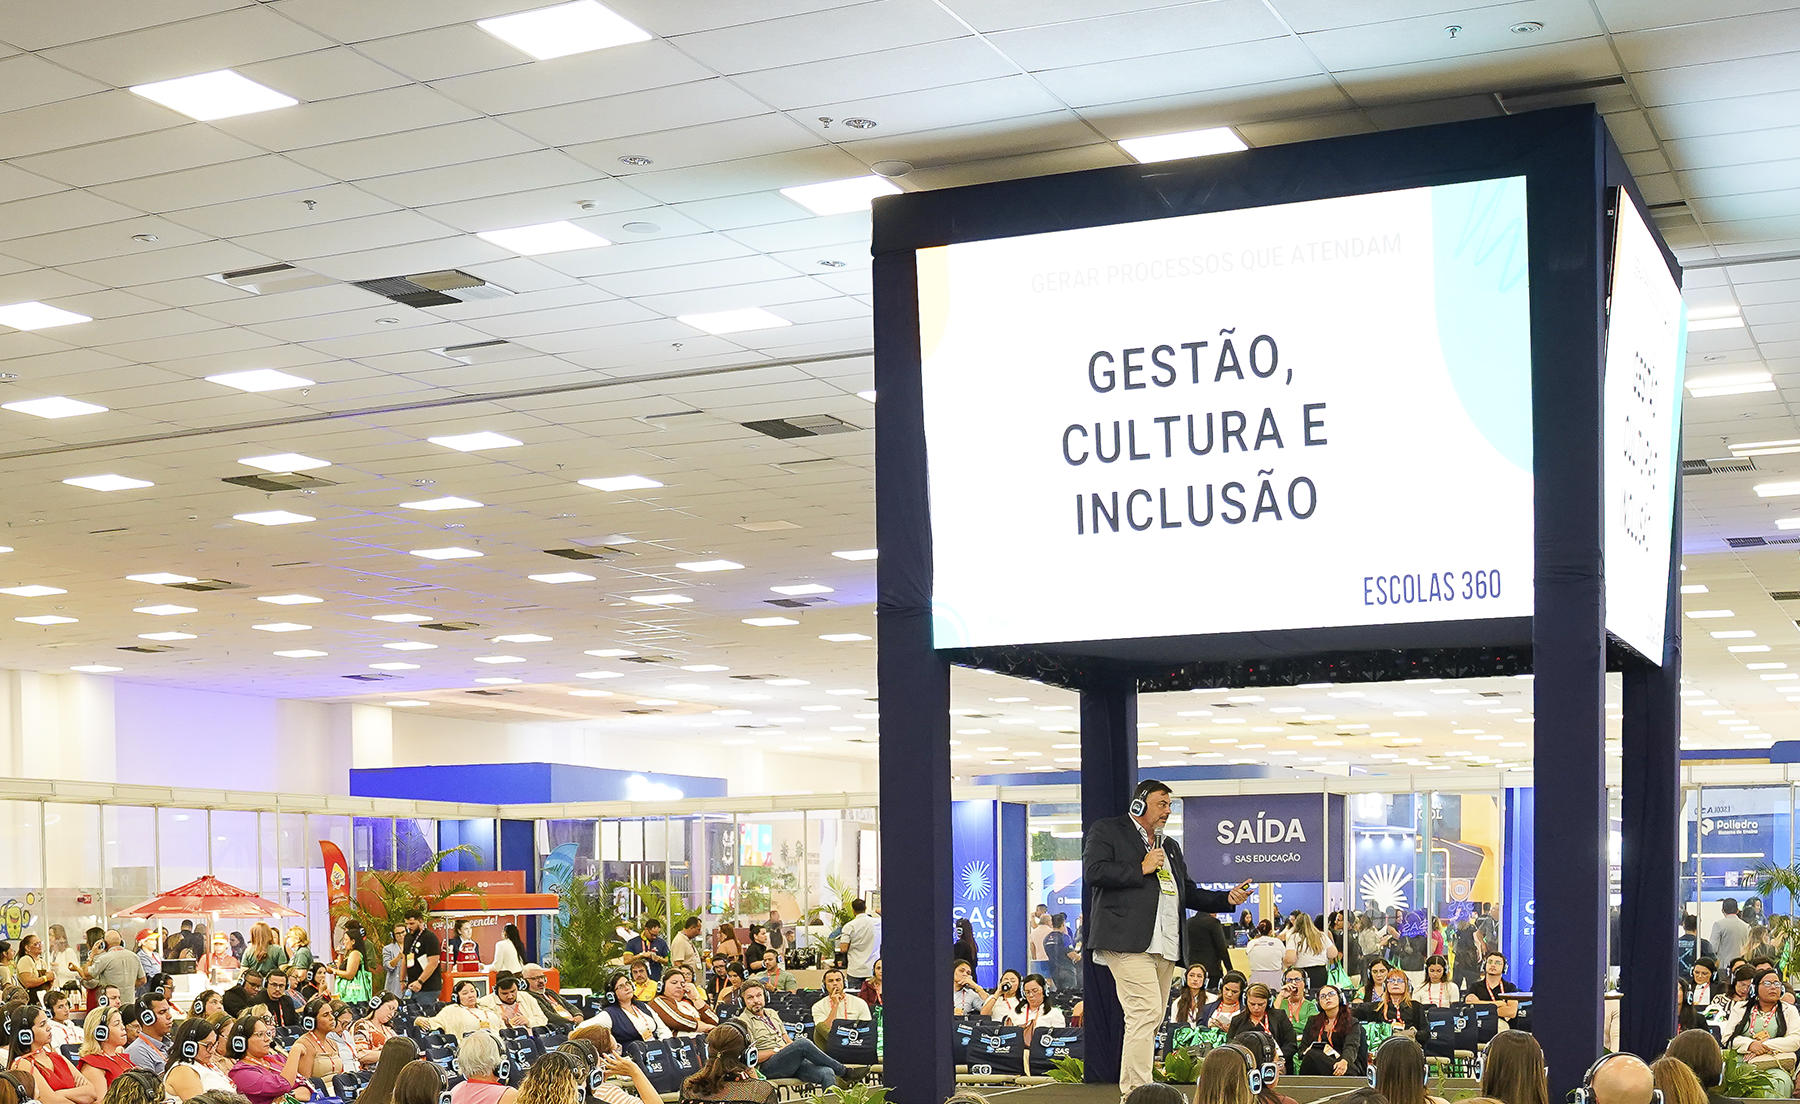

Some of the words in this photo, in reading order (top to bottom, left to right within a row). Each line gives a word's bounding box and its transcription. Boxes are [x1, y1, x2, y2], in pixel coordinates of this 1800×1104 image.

[1031, 267, 1100, 294] GERAR
[1106, 252, 1235, 286] PROCESSOS
[1240, 246, 1285, 272] QUE
[1291, 232, 1402, 265] ATENDAM
[1087, 326, 1295, 394] GESTÃO,
[1062, 407, 1285, 466] CULTURA
[1303, 402, 1329, 447] E
[1075, 467, 1318, 536] INCLUSÃO
[1364, 572, 1455, 606] ESCOLAS
[1462, 569, 1501, 599] 360
[1217, 811, 1307, 844] SAÍDA
[1717, 820, 1758, 829] Poliedro
[1235, 855, 1252, 863] SAS
[1253, 852, 1301, 863] EDUCAÇÃO
